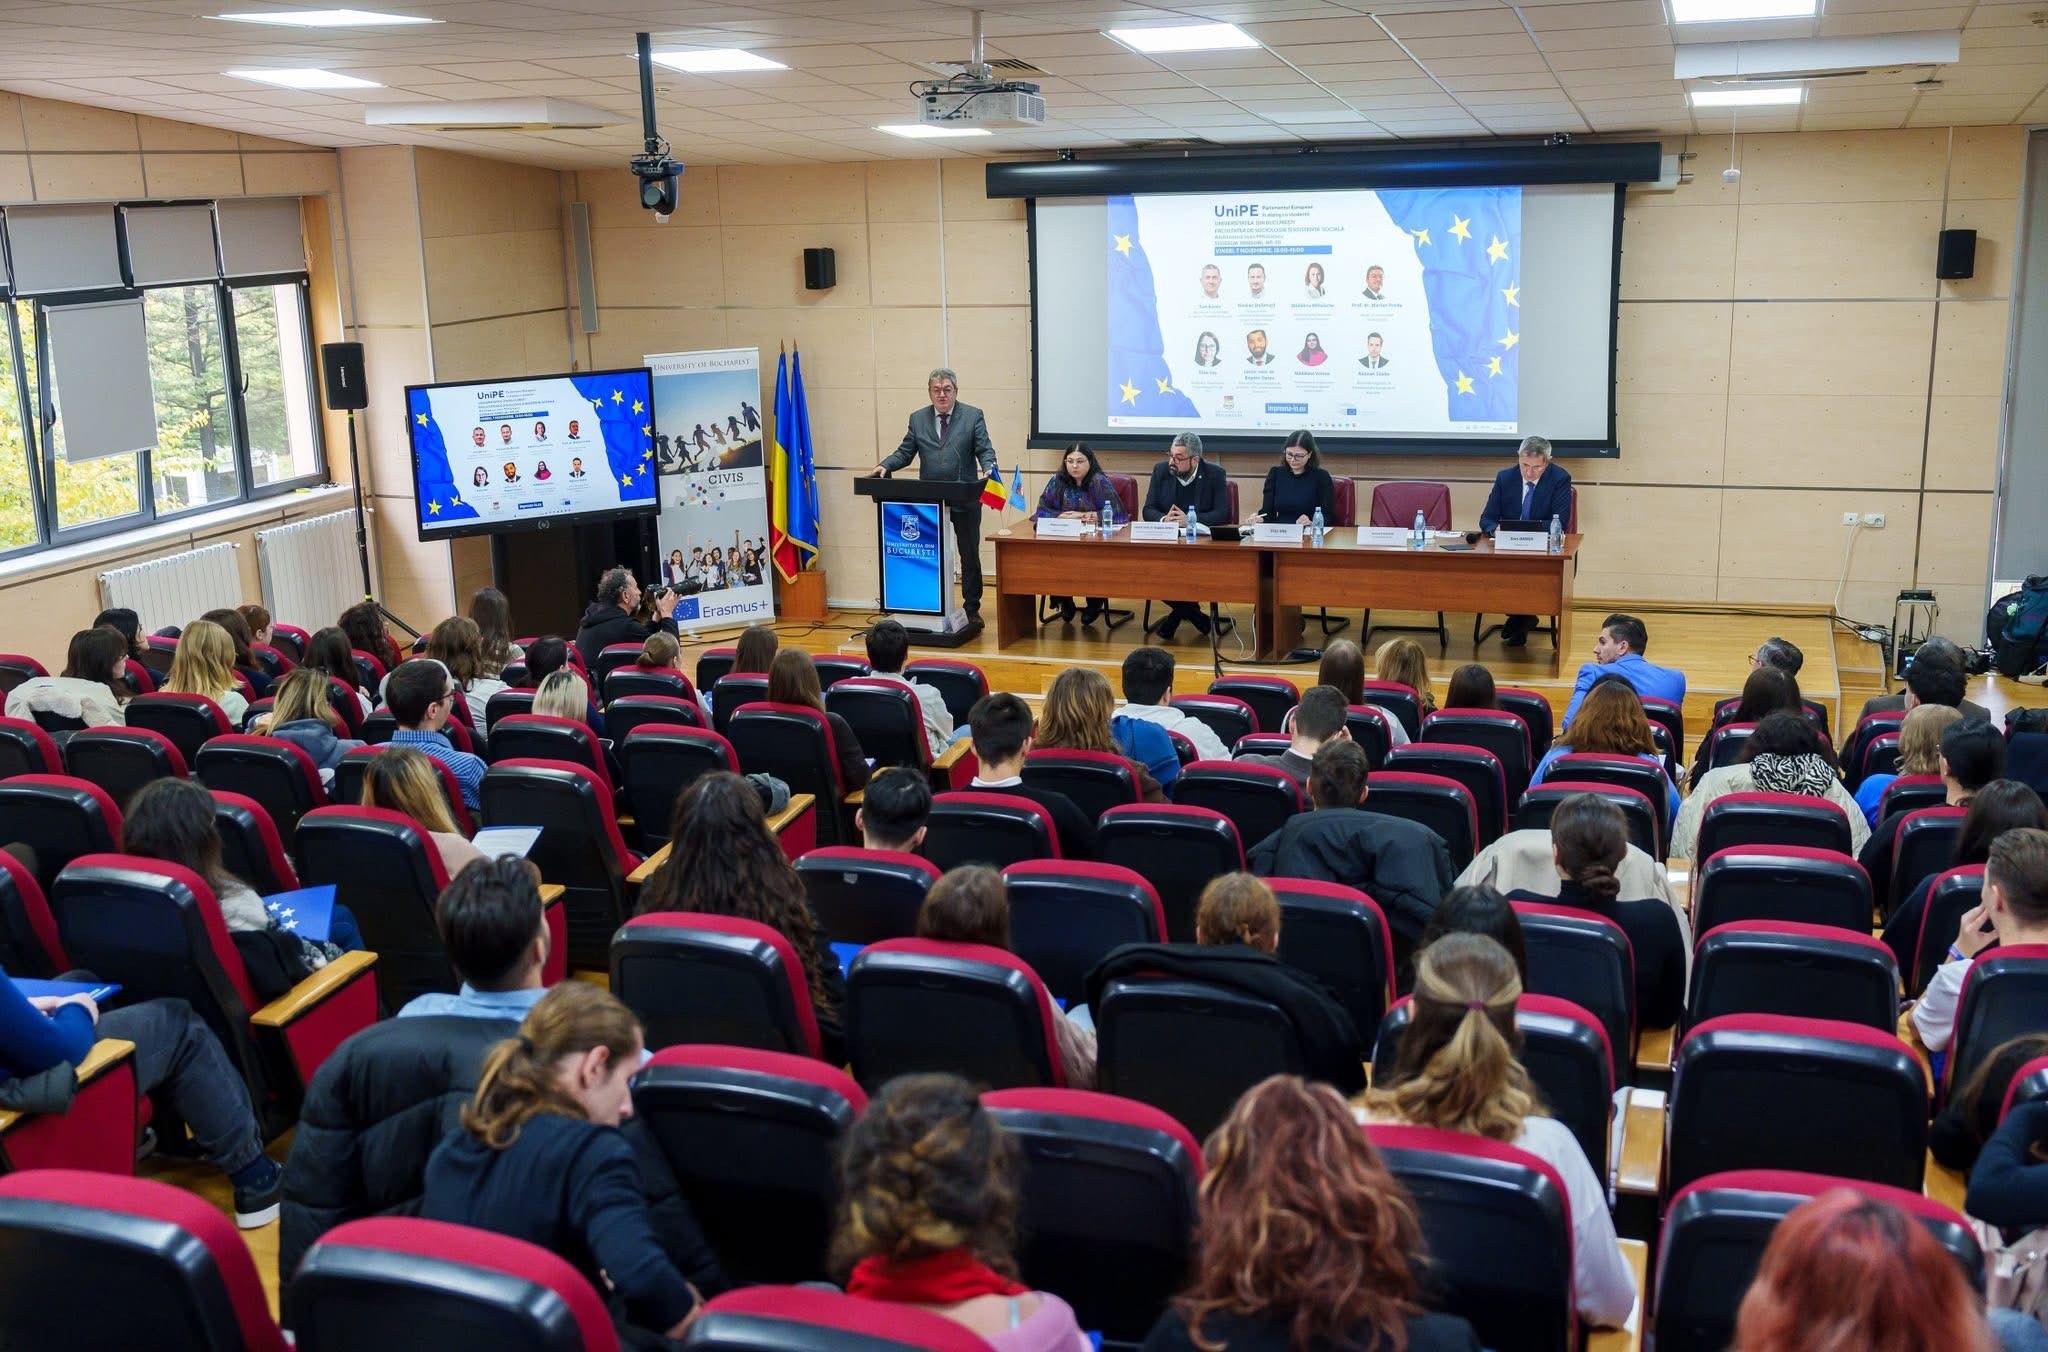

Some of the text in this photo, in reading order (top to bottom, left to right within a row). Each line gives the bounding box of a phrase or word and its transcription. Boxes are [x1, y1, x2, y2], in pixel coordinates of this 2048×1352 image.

[1214, 204, 1259, 217] UniPE
[710, 358, 750, 368] BUCHAREST
[477, 390, 504, 400] UniPE
[708, 472, 744, 485] CIVIS
[703, 600, 768, 618] Erasmus+
